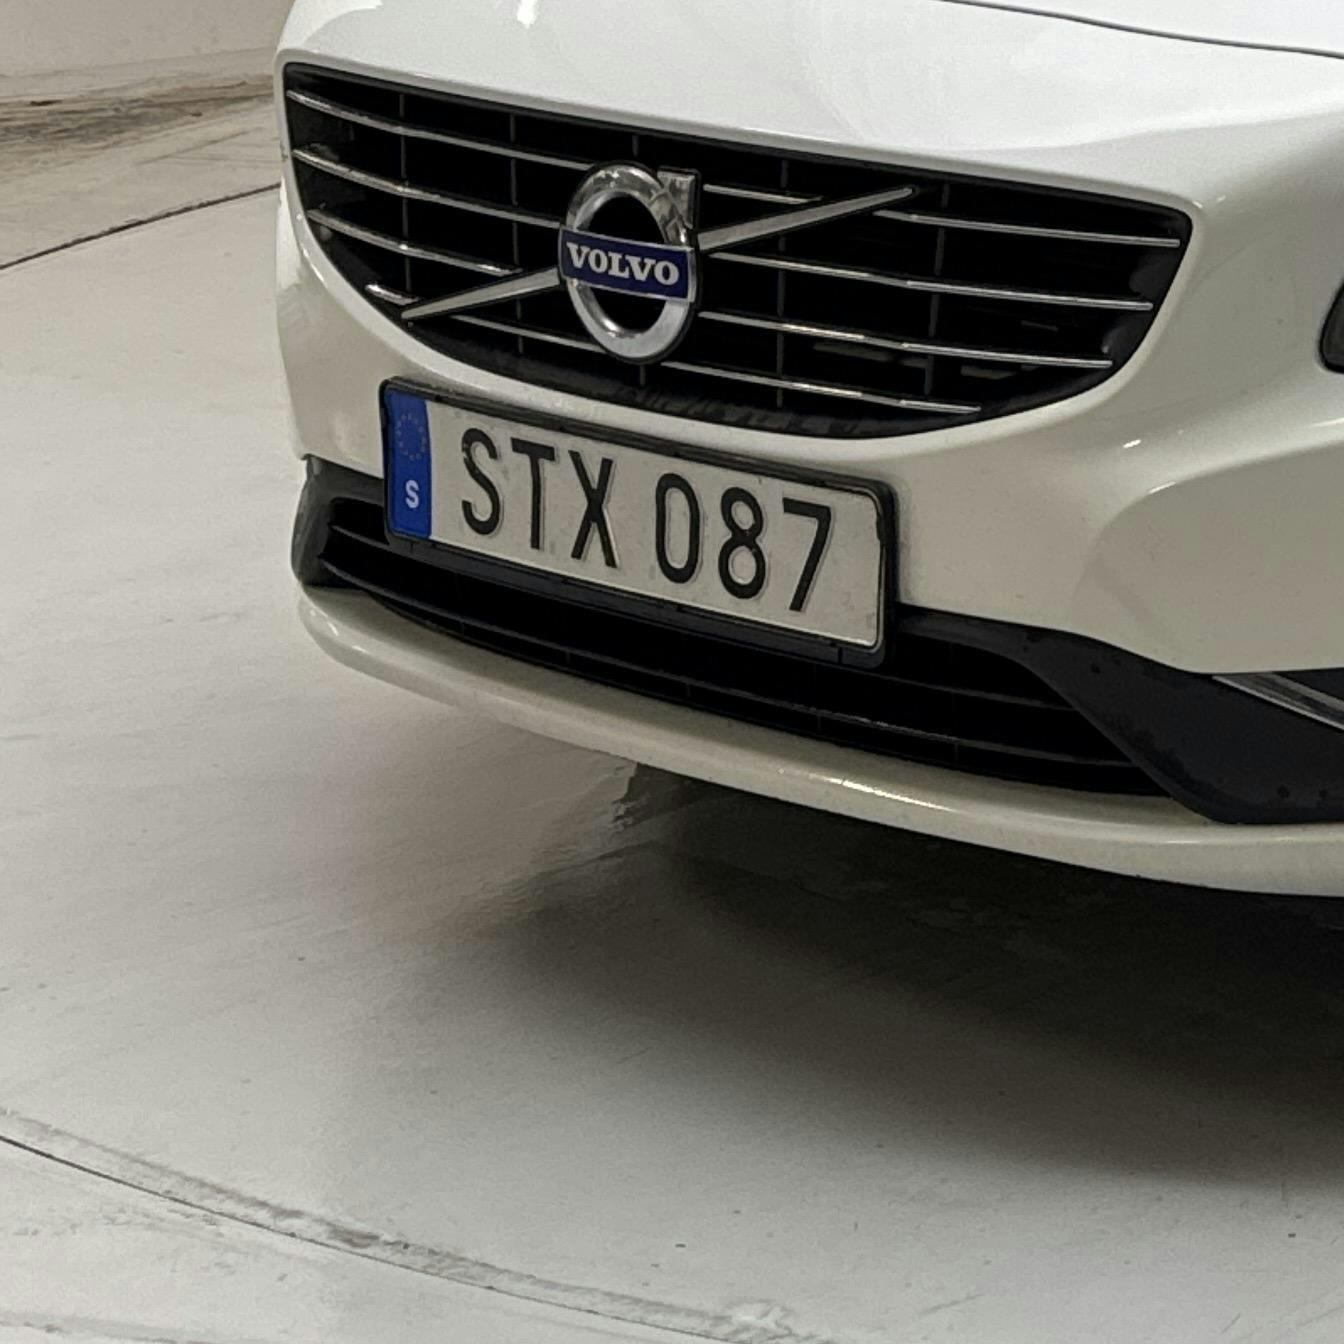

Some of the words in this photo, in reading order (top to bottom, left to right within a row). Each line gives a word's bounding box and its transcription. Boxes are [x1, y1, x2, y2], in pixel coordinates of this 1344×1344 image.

[566, 241, 680, 286] VOLVO
[404, 479, 420, 509] S
[460, 427, 618, 569] STX
[654, 472, 833, 613] 087
